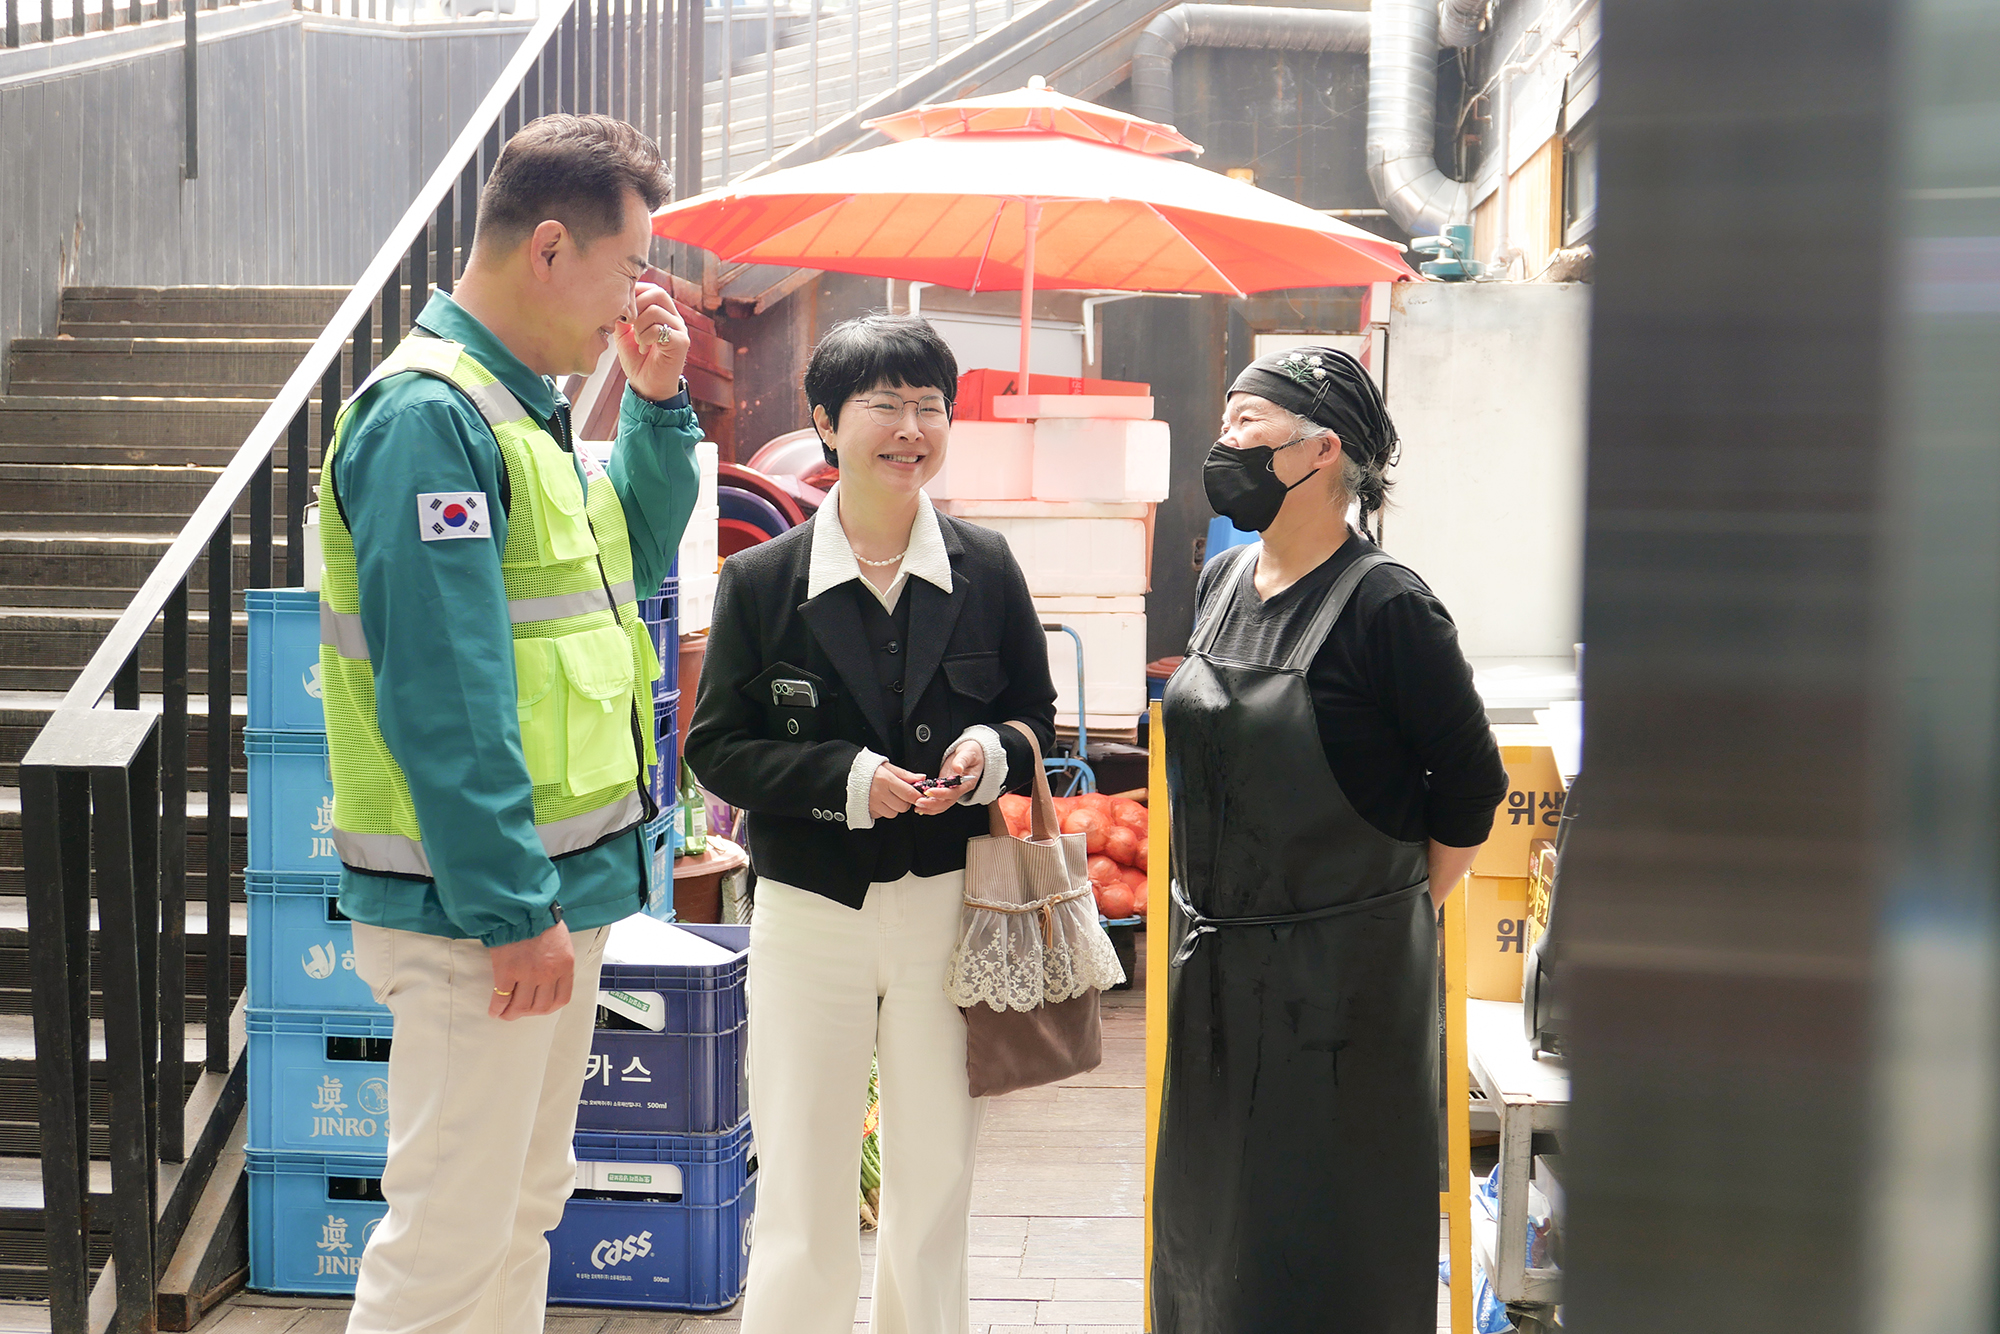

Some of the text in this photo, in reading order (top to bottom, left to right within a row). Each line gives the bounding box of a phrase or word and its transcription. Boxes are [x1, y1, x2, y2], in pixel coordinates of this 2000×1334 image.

[1508, 791, 1567, 826] 위생
[1496, 918, 1524, 953] 위
[584, 1054, 651, 1086] 카스
[309, 1117, 377, 1137] JINRO
